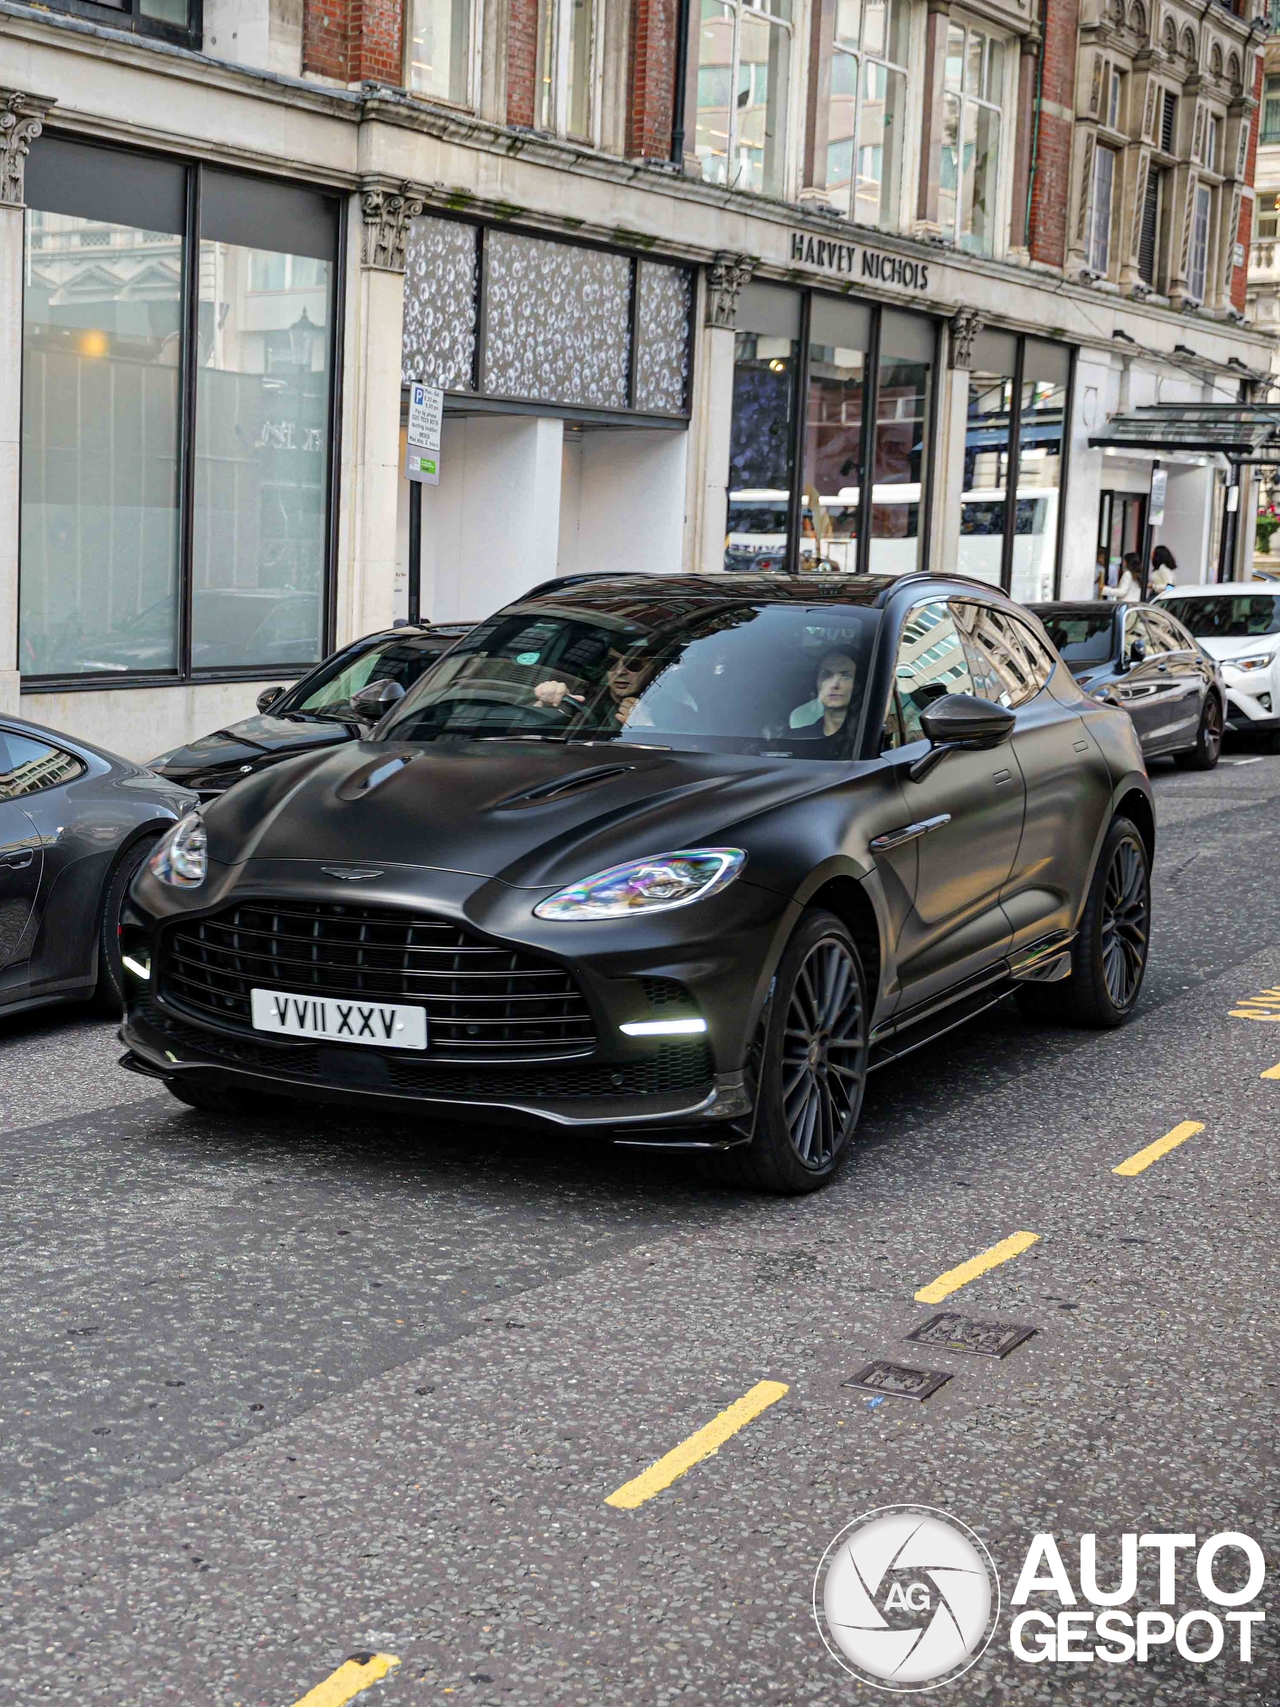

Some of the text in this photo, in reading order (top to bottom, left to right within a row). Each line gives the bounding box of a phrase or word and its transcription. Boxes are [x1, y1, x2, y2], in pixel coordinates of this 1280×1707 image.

[791, 232, 929, 291] HARVEY NICHOLS
[336, 1004, 397, 1039] XXV
